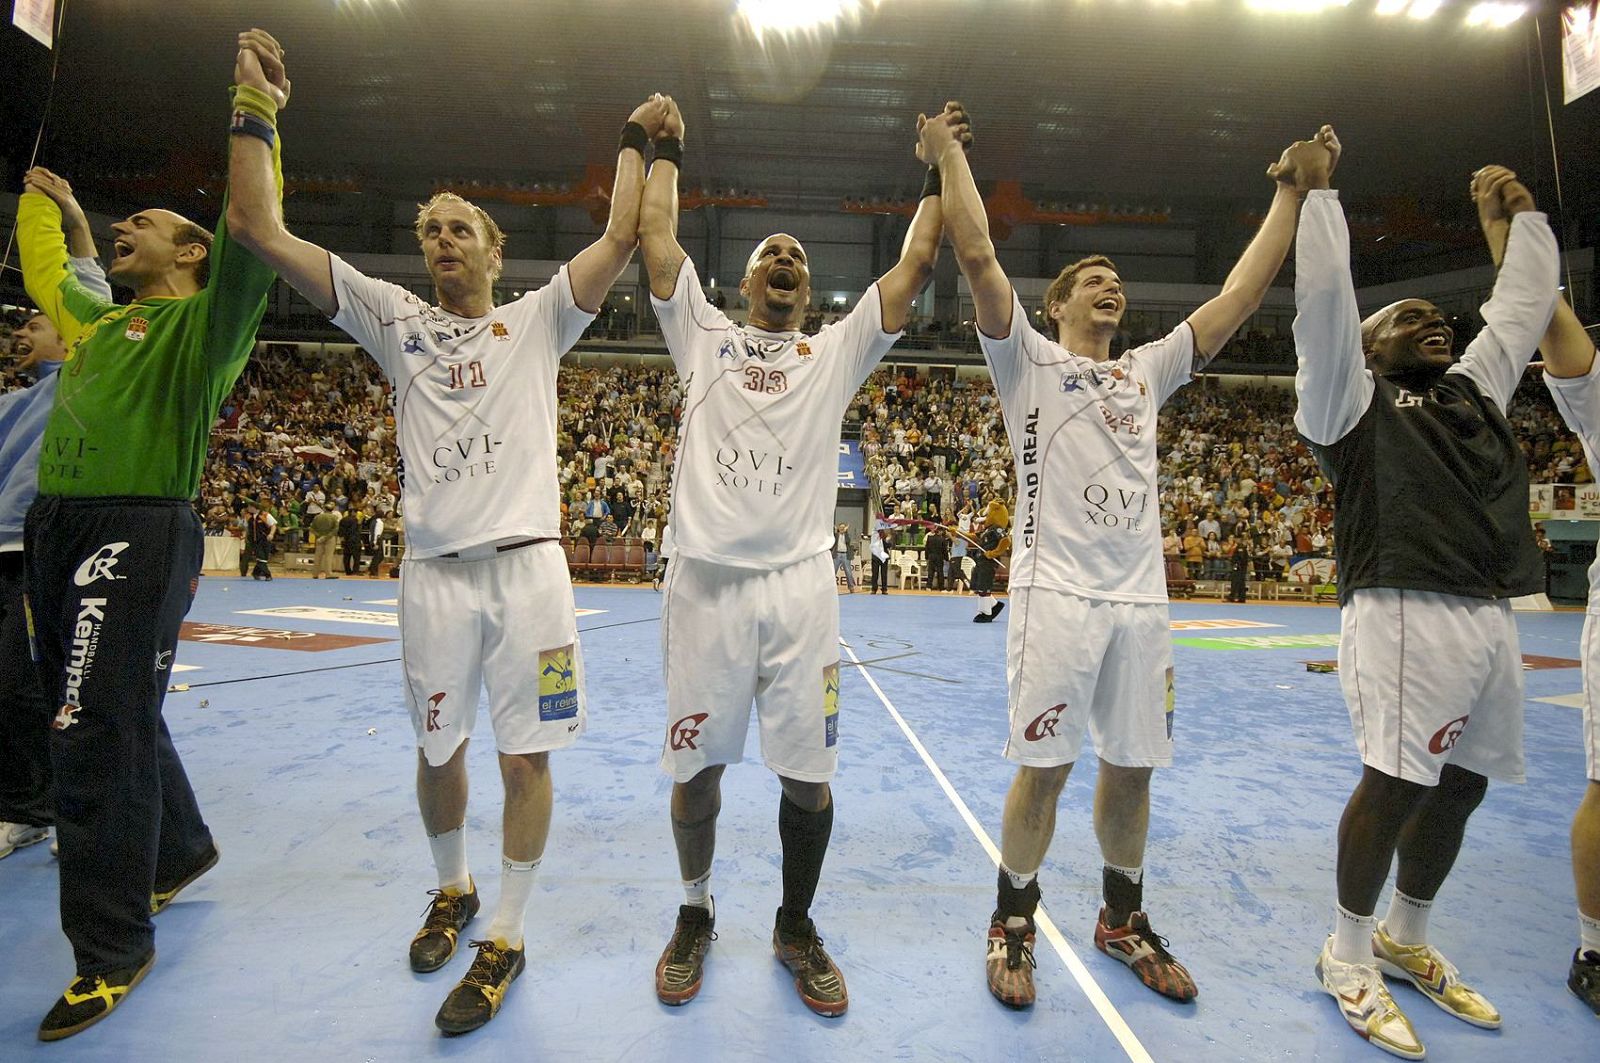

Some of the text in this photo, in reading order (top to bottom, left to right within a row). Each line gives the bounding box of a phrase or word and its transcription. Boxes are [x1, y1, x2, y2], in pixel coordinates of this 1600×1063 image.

[449, 361, 488, 390] 11
[743, 366, 788, 395] 33
[1023, 407, 1040, 466] REAL
[716, 447, 793, 475] QVI-
[716, 472, 783, 497] XOTE
[65, 597, 108, 708] Kempa
